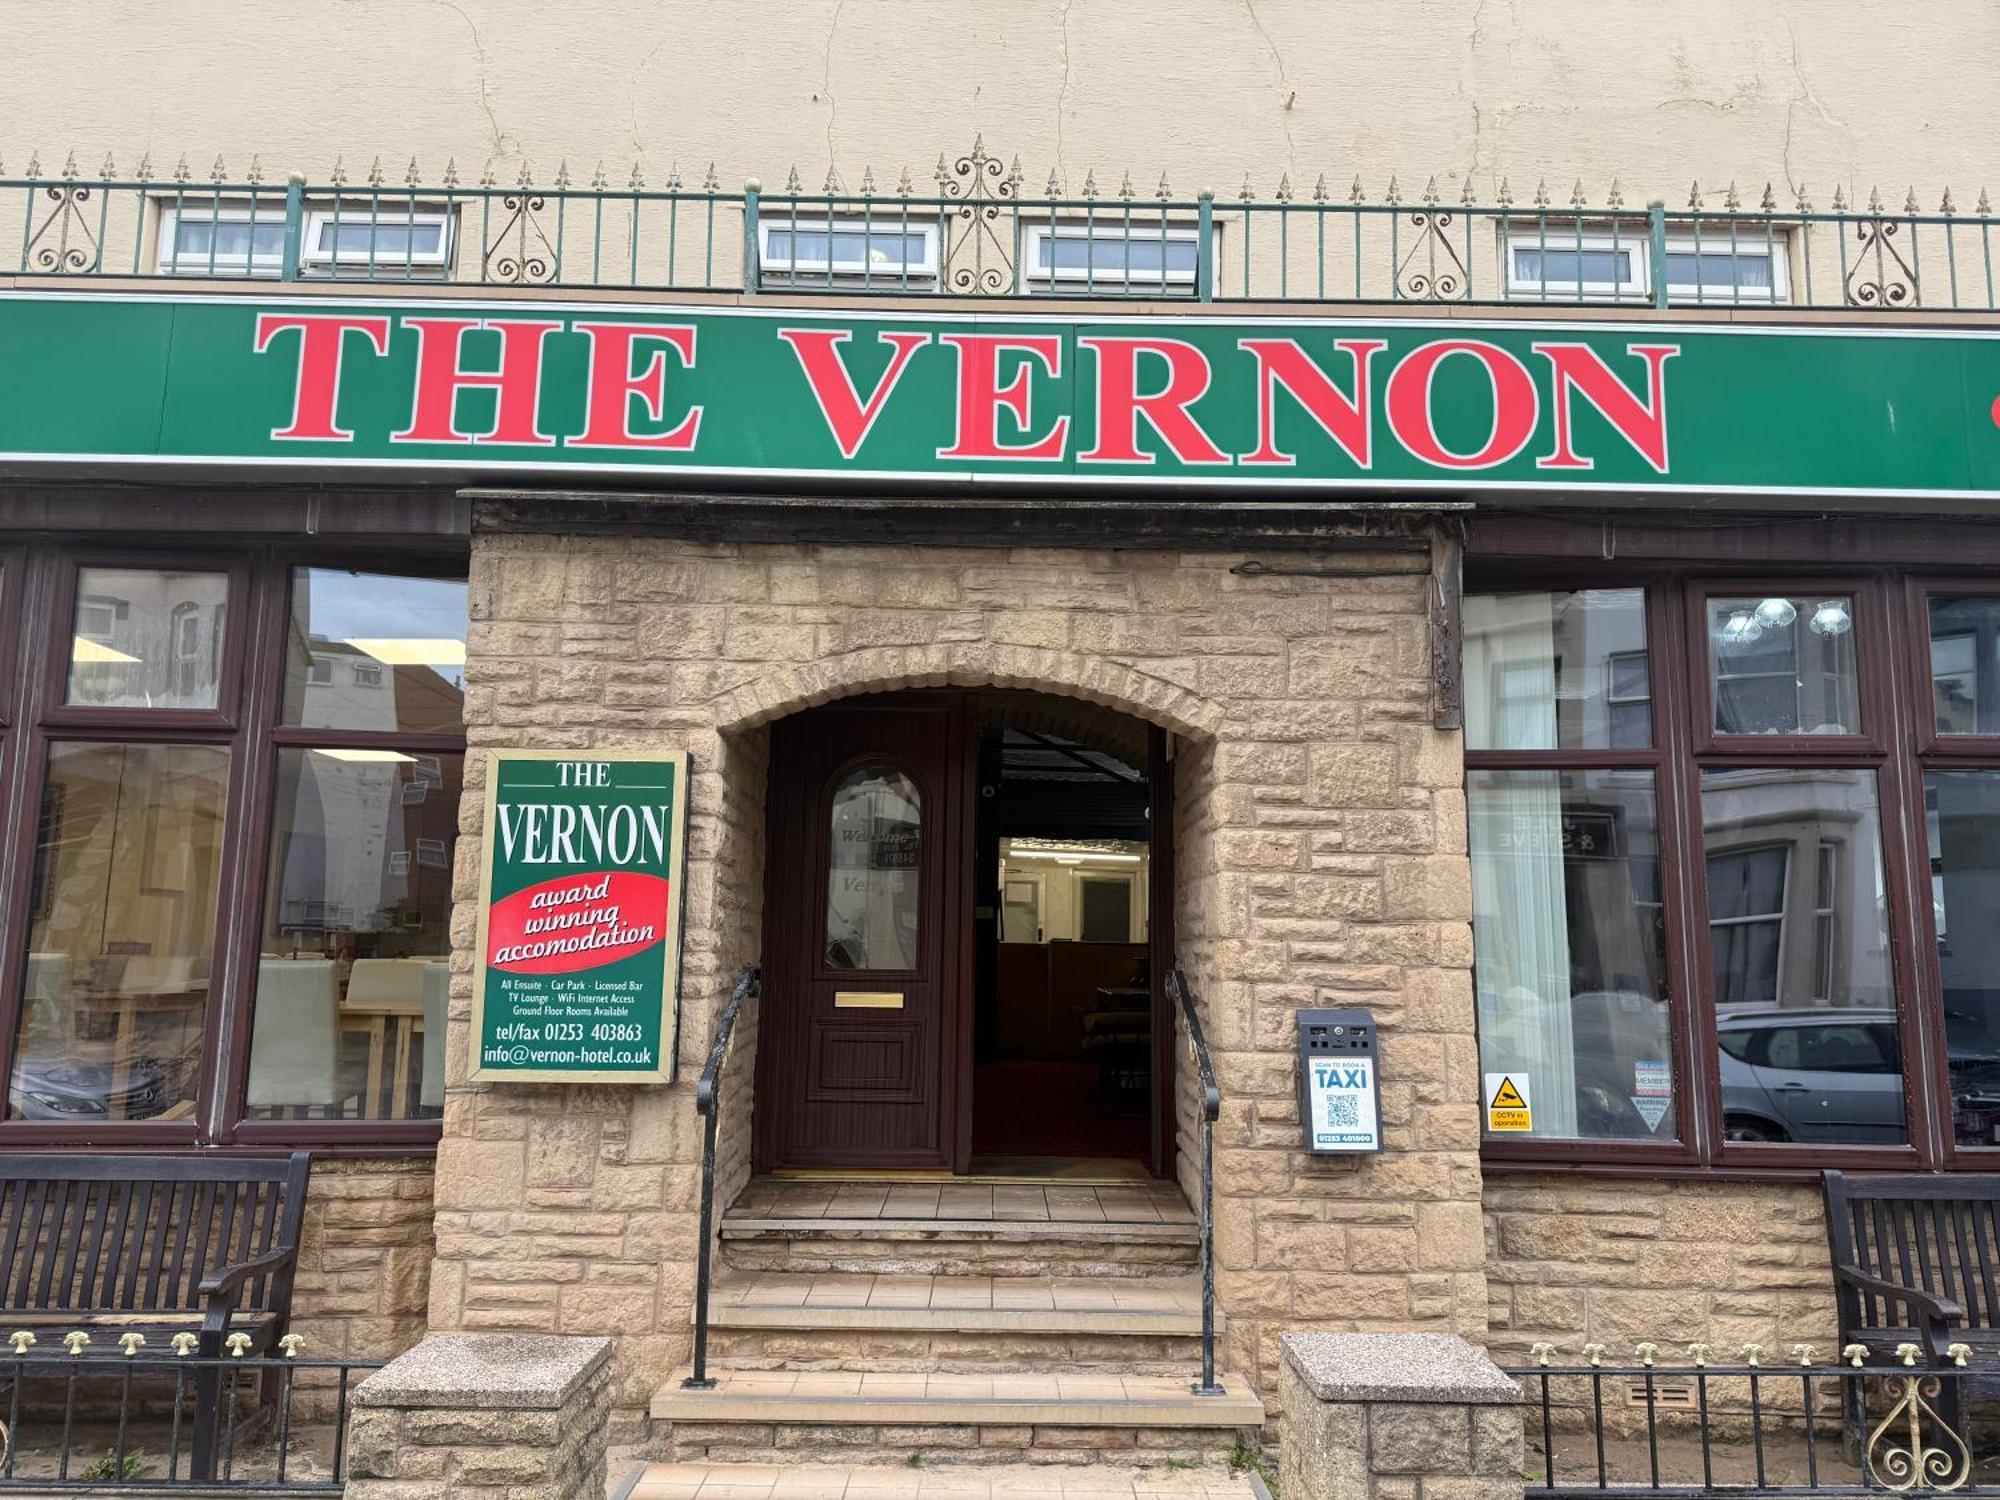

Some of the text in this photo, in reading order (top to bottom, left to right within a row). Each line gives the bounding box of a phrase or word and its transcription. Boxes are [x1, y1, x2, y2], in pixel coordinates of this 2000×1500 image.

[253, 312, 1682, 475] THE VERNON
[556, 762, 611, 787] THE
[497, 804, 669, 865] VERNON
[530, 874, 612, 909] award
[524, 902, 620, 936] winning
[493, 921, 655, 965] accomodation
[501, 980, 643, 991] All Ensuite Car Park Licensed Bar
[508, 993, 635, 1005] TV Lounge WiFi Internet Access
[513, 1006, 629, 1017] Ground Floor Rooms Available
[496, 1023, 643, 1041] tel/fax 01253 403863
[484, 1045, 652, 1065] info@vernon-hotel.co.uk
[1315, 1069, 1367, 1089] TAXI
